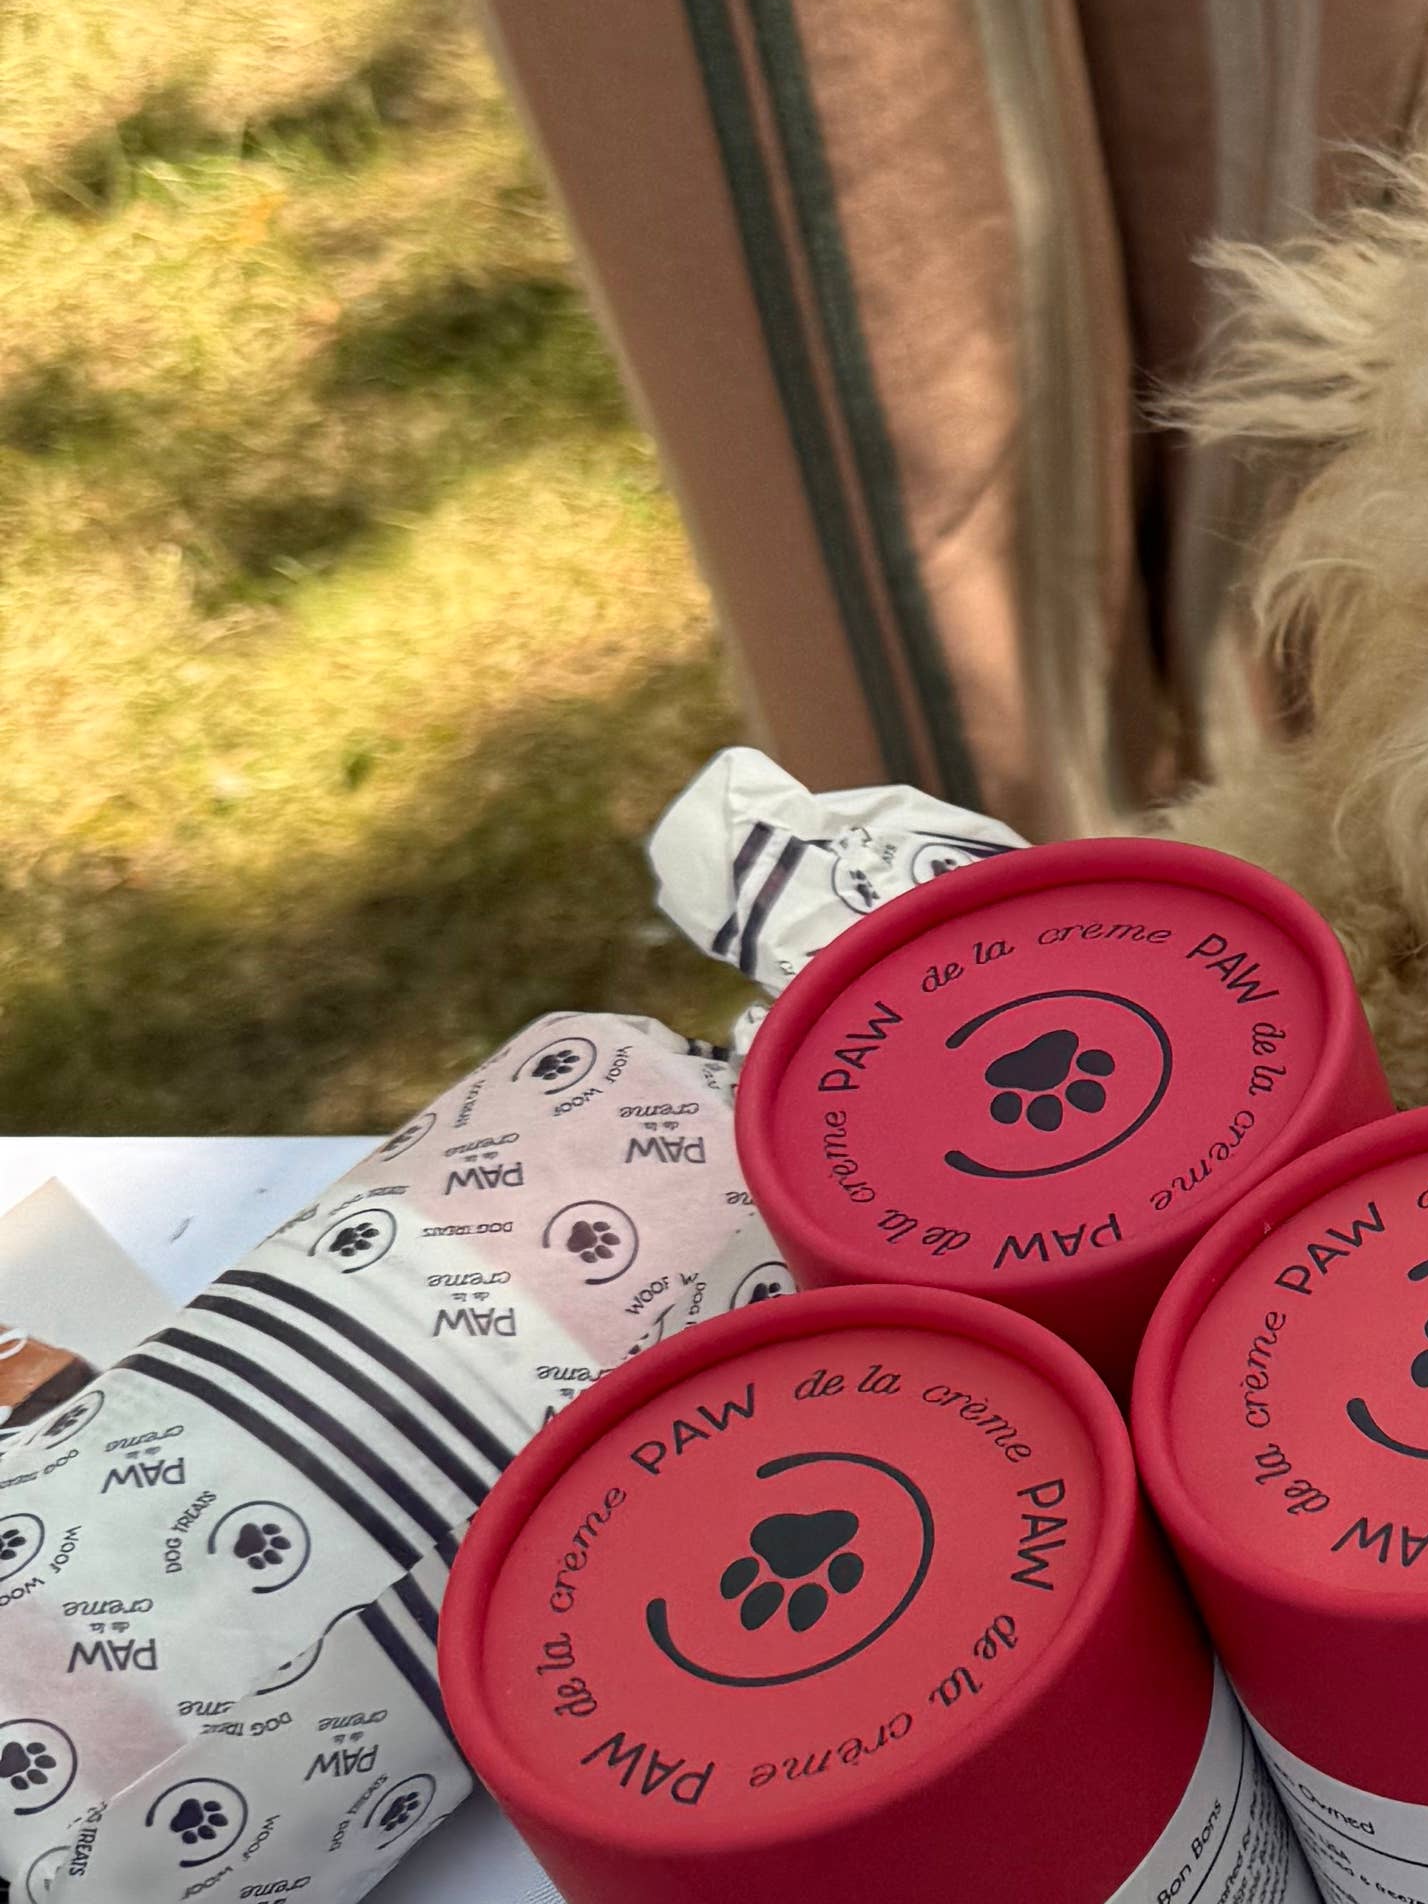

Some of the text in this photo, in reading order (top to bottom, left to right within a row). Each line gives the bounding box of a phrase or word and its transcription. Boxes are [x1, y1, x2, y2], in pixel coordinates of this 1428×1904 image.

[972, 940, 1015, 965] la
[1185, 933, 1280, 1005] PAW
[921, 962, 964, 993] de
[817, 1000, 903, 1092] PAW
[1251, 1022, 1287, 1056] de
[1248, 1065, 1287, 1097] la
[625, 1136, 706, 1164] PAW
[445, 1161, 524, 1195] PAW
[877, 1209, 918, 1245] la
[921, 1226, 971, 1257] de
[993, 1212, 1122, 1270] PAW
[1274, 1201, 1386, 1296] PAW
[432, 1307, 517, 1338] PAW
[794, 1369, 845, 1401] de
[857, 1364, 902, 1395] la
[629, 1383, 755, 1476] PAW
[100, 1456, 186, 1494] PAW
[1254, 1442, 1293, 1486] la
[1283, 1479, 1331, 1515] de
[1009, 1478, 1068, 1591] PAW
[164, 1537, 183, 1574] DOG
[62, 1598, 153, 1616] creme
[67, 1638, 158, 1673] PAW
[535, 1632, 576, 1677] la
[973, 1614, 1018, 1661] de
[553, 1676, 598, 1718] de
[928, 1666, 983, 1708] la
[304, 1744, 379, 1781] PAW
[580, 1731, 715, 1806] PAW
[1190, 1799, 1222, 1860] Bons
